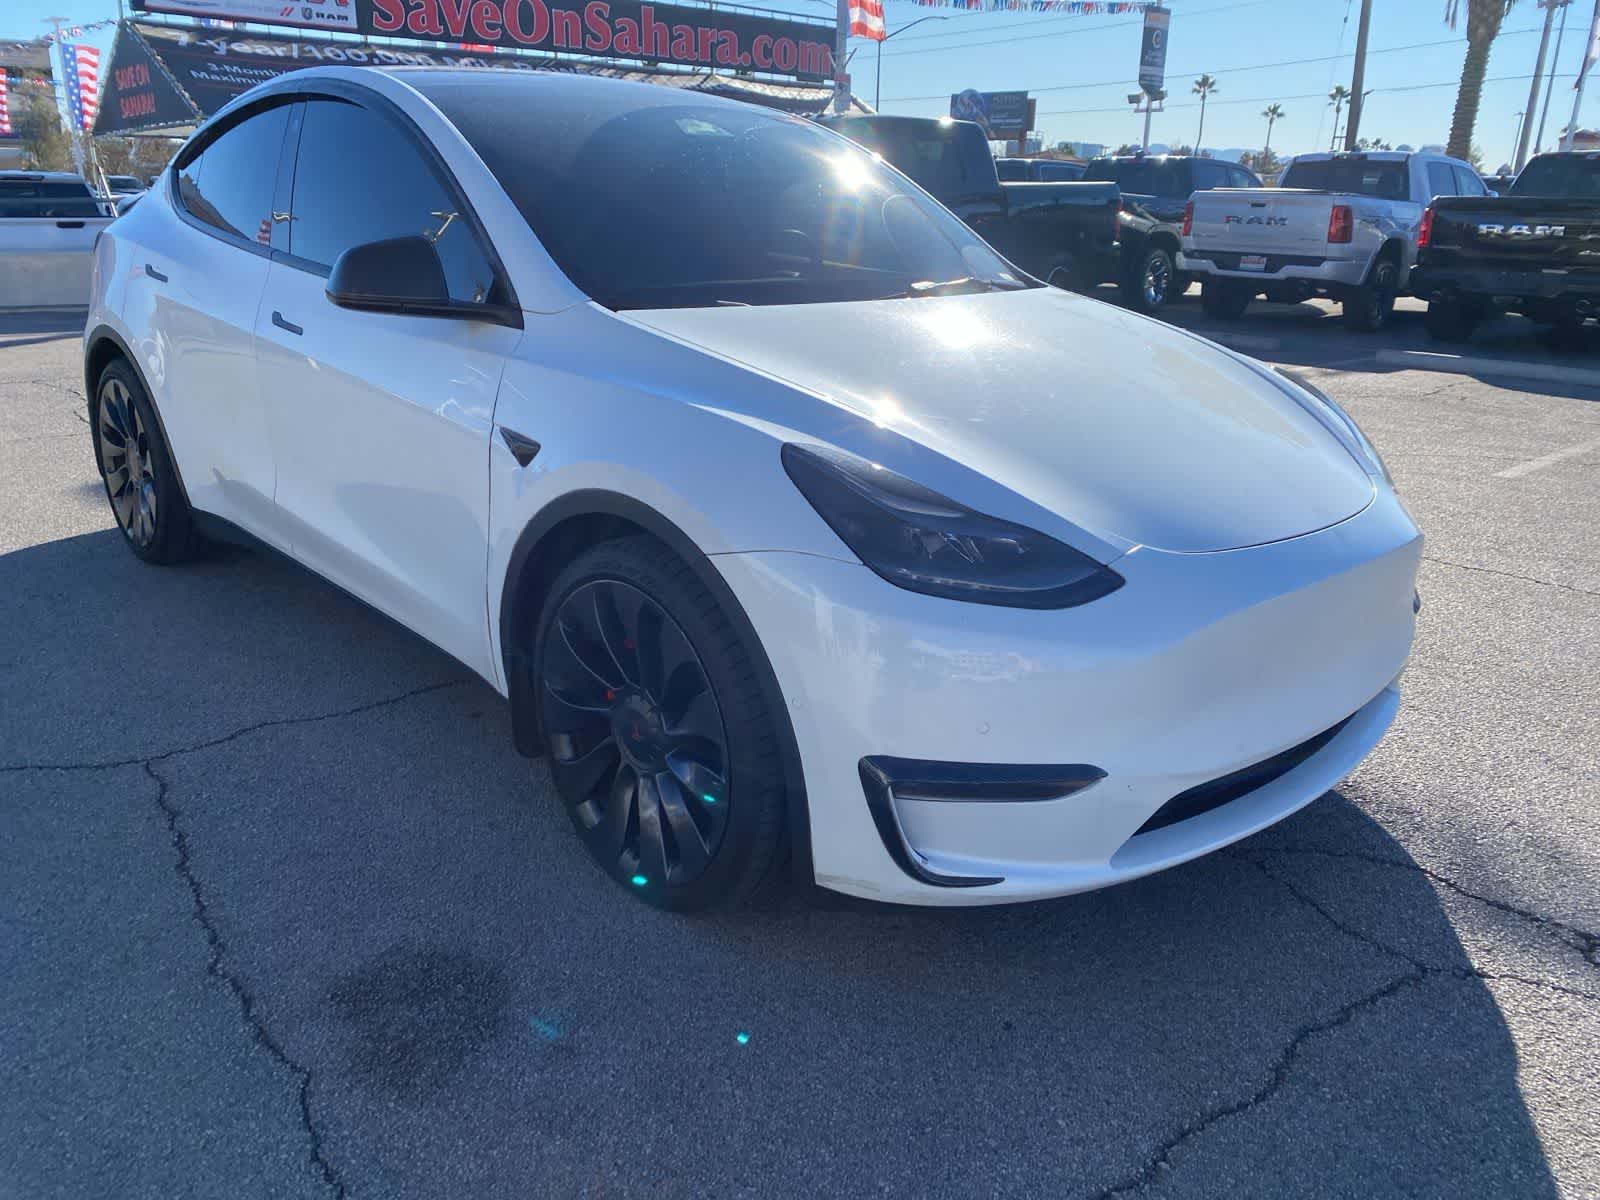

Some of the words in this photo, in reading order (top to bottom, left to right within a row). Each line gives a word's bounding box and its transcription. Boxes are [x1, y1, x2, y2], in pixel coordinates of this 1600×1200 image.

[314, 12, 349, 22] RAM
[372, 0, 831, 76] SaveOnSahara.com
[189, 69, 267, 85] Maximu
[207, 62, 288, 78] 3-Month/
[1224, 215, 1289, 226] RAM
[1477, 223, 1566, 237] RAM
